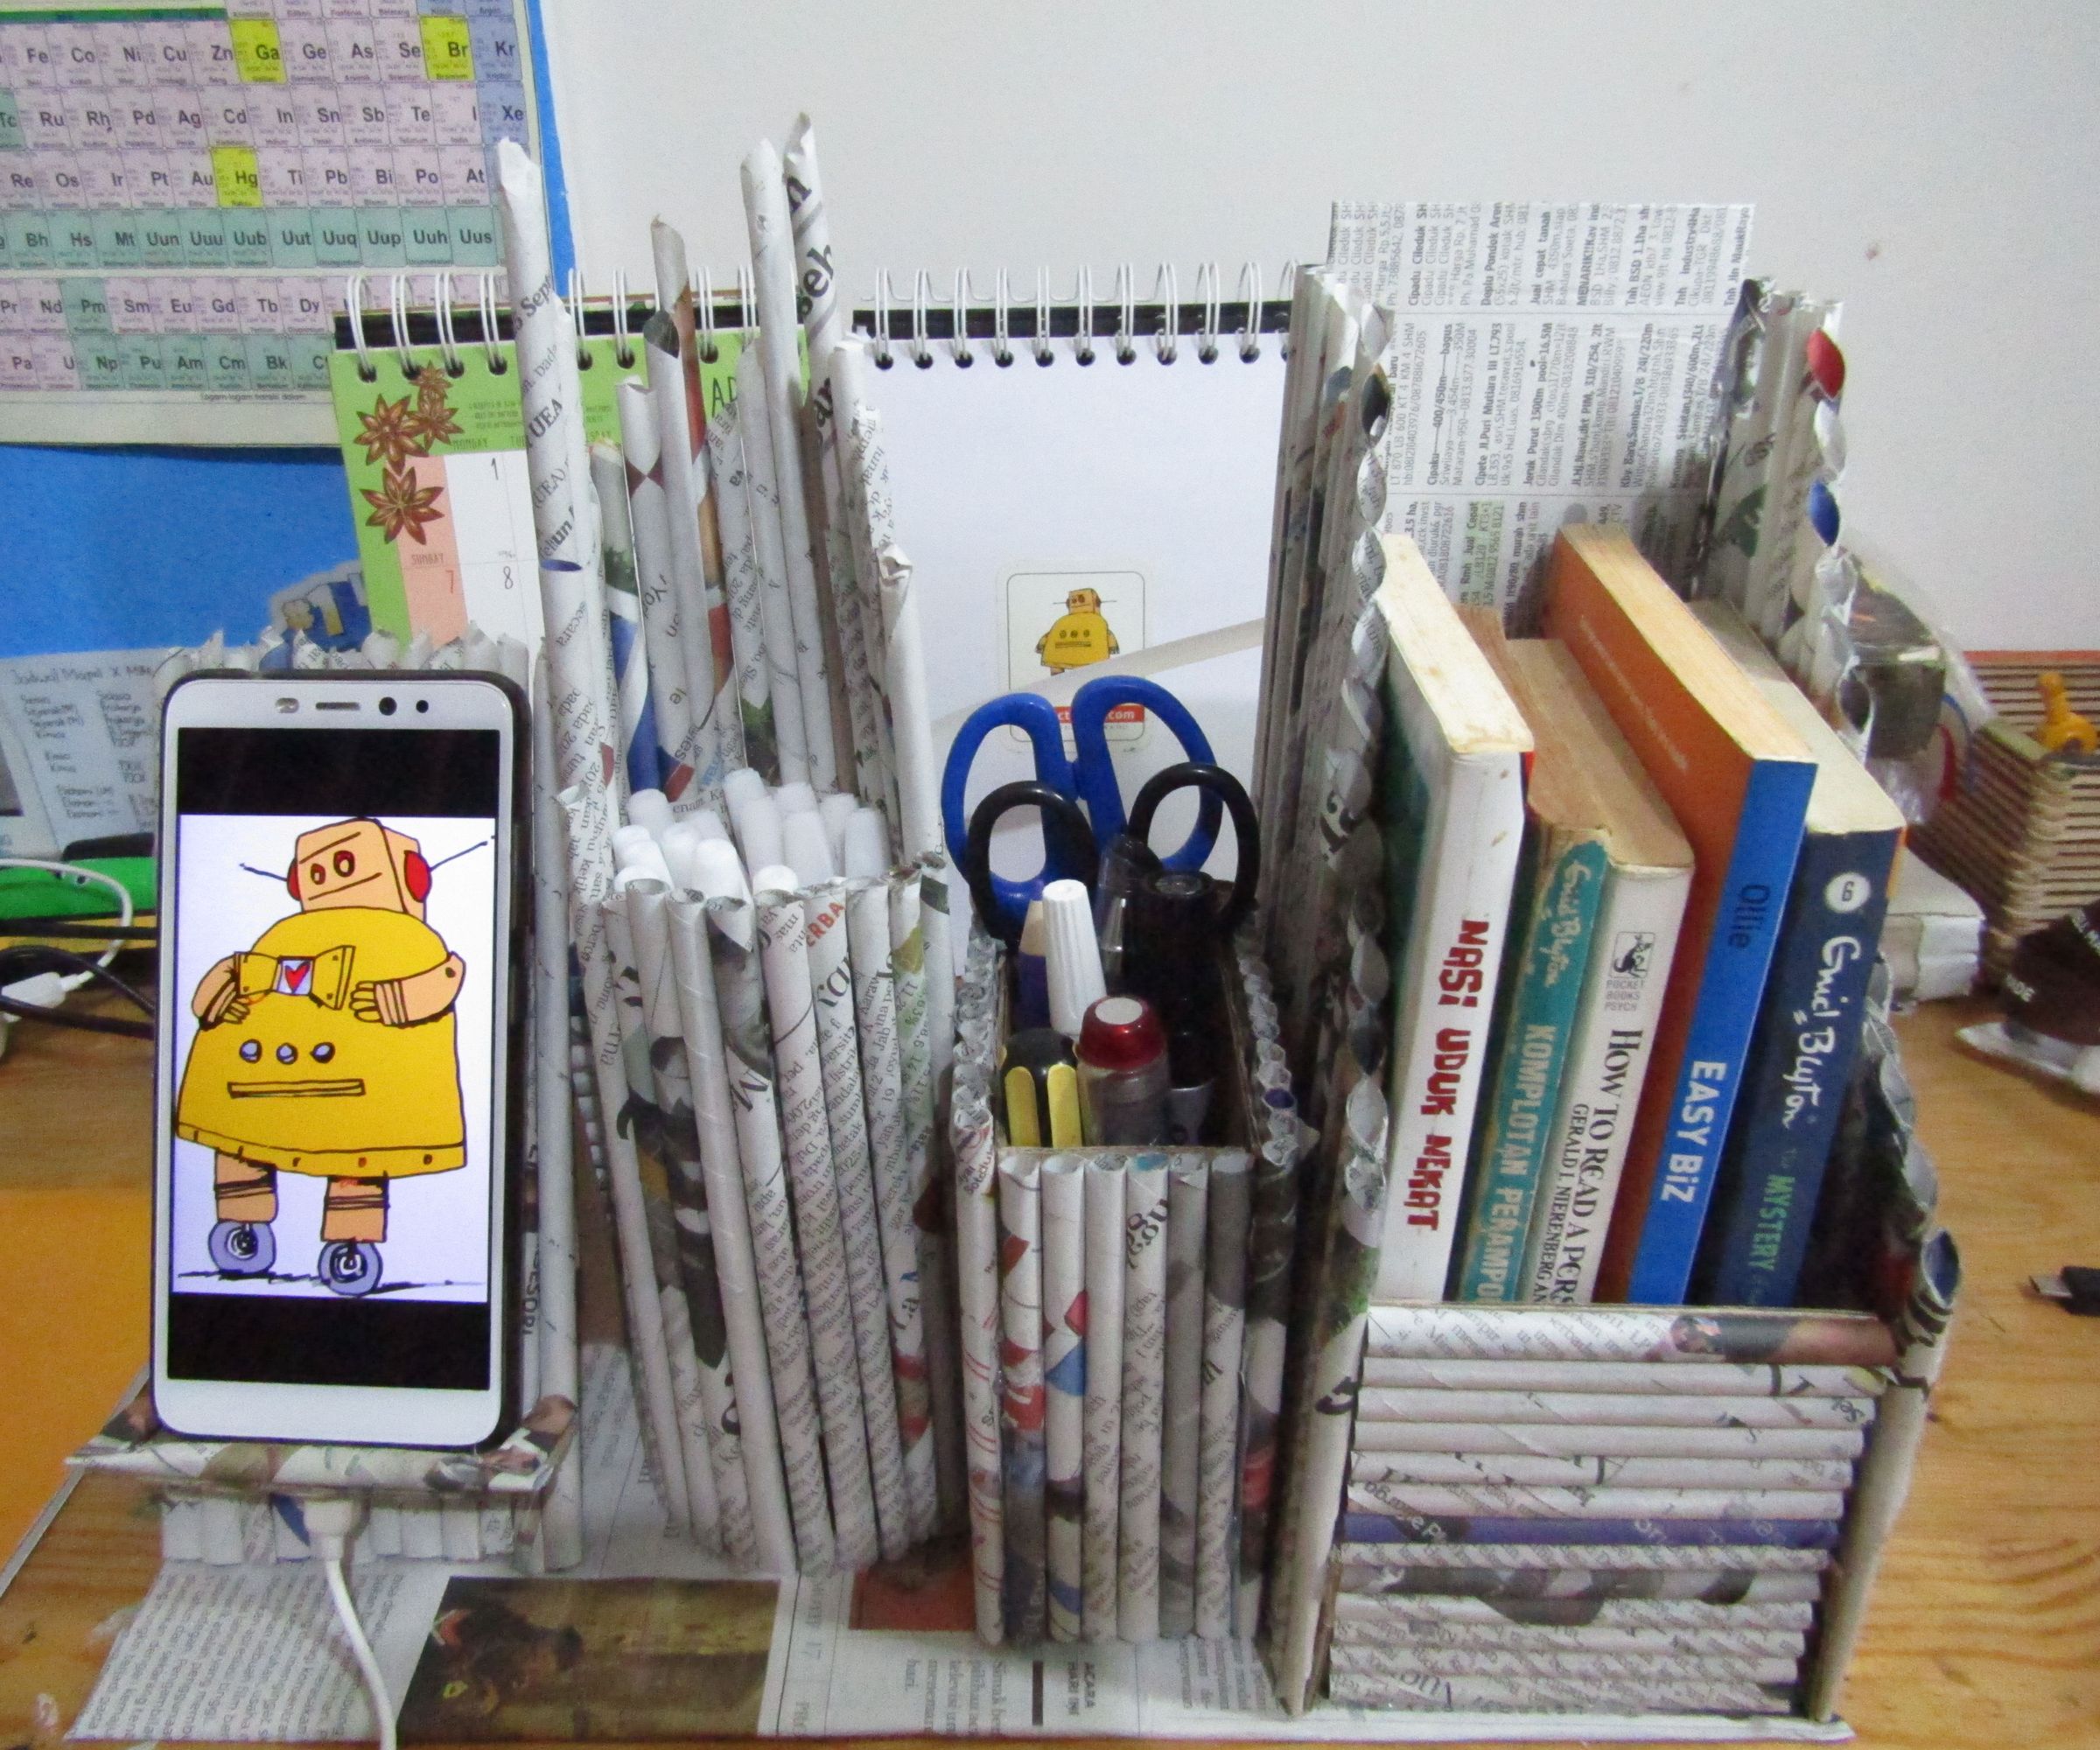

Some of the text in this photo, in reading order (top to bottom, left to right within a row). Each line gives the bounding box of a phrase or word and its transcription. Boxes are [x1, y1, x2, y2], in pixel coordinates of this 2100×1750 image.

[27, 41, 515, 63] Fe Co Ni Cu Zn Ga Ge As Se Br Kr
[40, 111, 64, 127] Ru
[87, 111, 110, 126] Rh
[133, 110, 155, 125] Pd
[178, 109, 200, 128] Ag
[224, 108, 247, 123] Cd
[277, 108, 293, 123] In
[318, 108, 340, 122] Sn
[363, 108, 384, 122] Sb
[411, 107, 430, 122] Te
[502, 106, 523, 121] Xe
[10, 169, 485, 189] Re Os Ir Pt Au Hg Pb Bi Po At
[283, 230, 312, 245] Uut
[323, 231, 356, 248] Uuq
[368, 230, 402, 248] Uup
[413, 229, 447, 245] Uuh
[460, 229, 492, 244] Uus
[1, 298, 319, 315] Pr Nd Pm Sm Eu Gd Tb Dy
[12, 356, 287, 372] Pa U Np Pu Am Cm Bk
[503, 565, 514, 590] 8
[1420, 1026, 1471, 1116] UDUK
[1602, 1029, 1643, 1098] HOW
[1498, 1025, 1557, 1176] KOMPLOTAN
[1676, 1060, 1727, 1146] EASY
[1562, 1102, 1590, 1169] GERALD
[1588, 1102, 1620, 1142] TO
[1564, 1222, 1590, 1240] A
[1748, 1174, 1796, 1270] MYSTERY
[1476, 1186, 1523, 1303] PERAMPO
[1551, 1245, 1587, 1303] PERS
